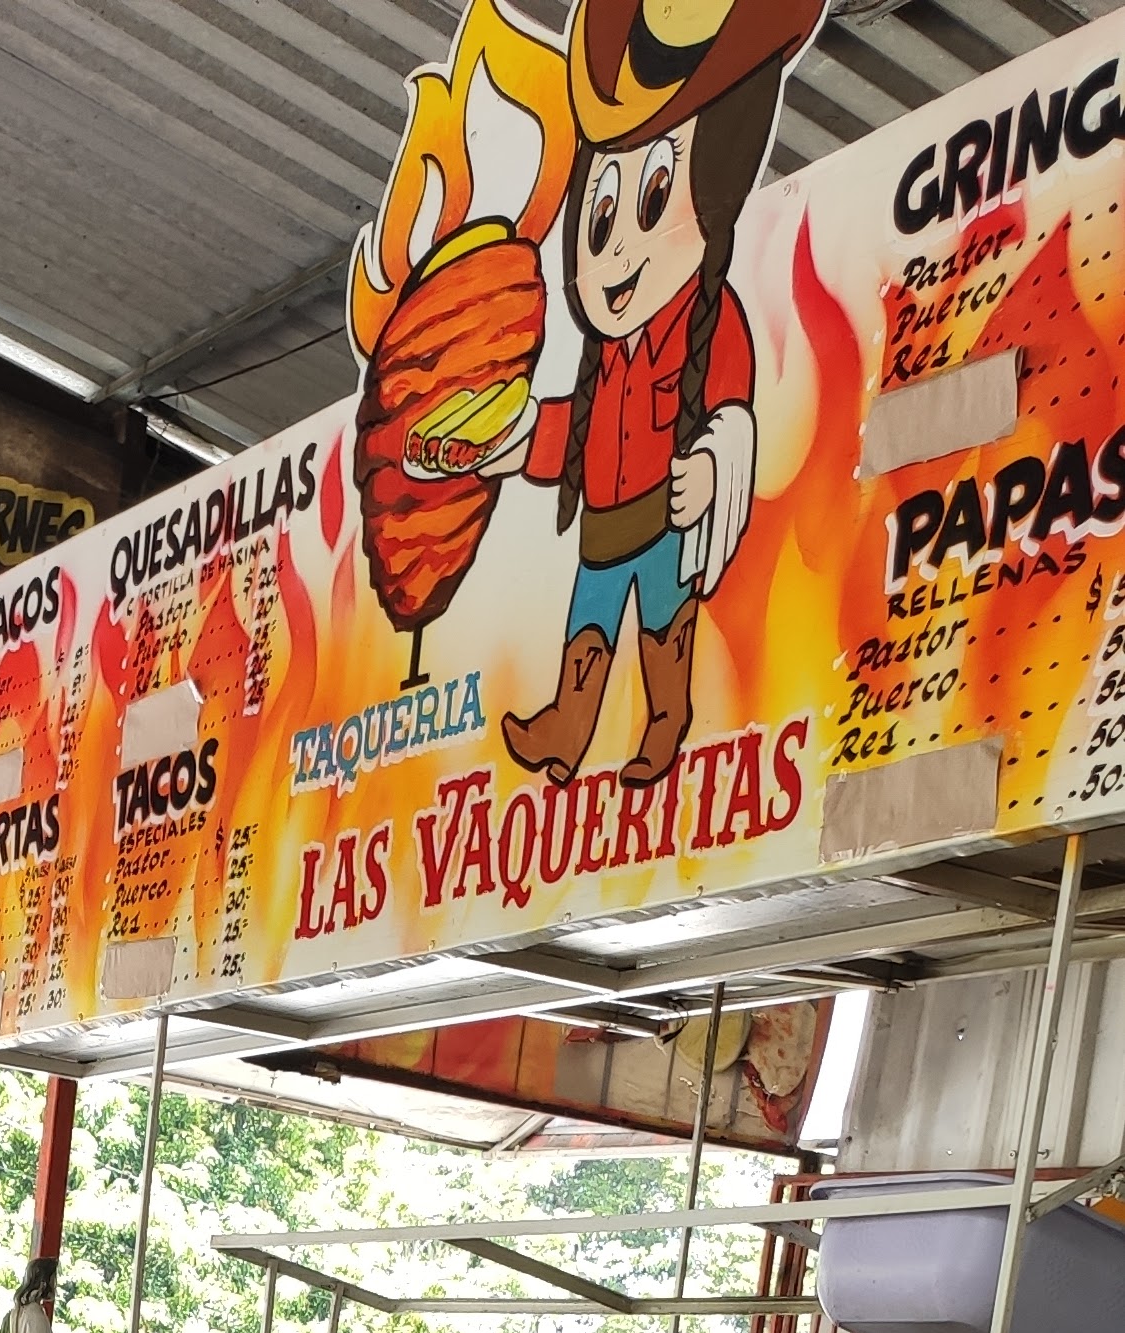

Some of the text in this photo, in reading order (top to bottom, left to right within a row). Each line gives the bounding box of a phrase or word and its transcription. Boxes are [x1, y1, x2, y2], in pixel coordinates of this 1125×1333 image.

[898, 223, 1016, 300] Pastor
[891, 272, 1006, 345] Puerco
[110, 443, 318, 611] QUESADILLAS
[892, 424, 1125, 582] PAPAS
[886, 542, 1088, 622] RELLENAS
[133, 629, 188, 668] Puerco
[135, 599, 193, 642] Pastor
[846, 616, 970, 682] Pastor
[837, 624, 1125, 726] Puerco 5
[292, 670, 485, 785] TAQUERIA
[832, 721, 898, 766] Res
[115, 738, 218, 831] TACOS
[118, 810, 207, 855] ESPECIALES
[295, 716, 813, 940] LAS VAQUERITAS
[111, 879, 168, 912] Puerco
[114, 848, 170, 884] Pastor
